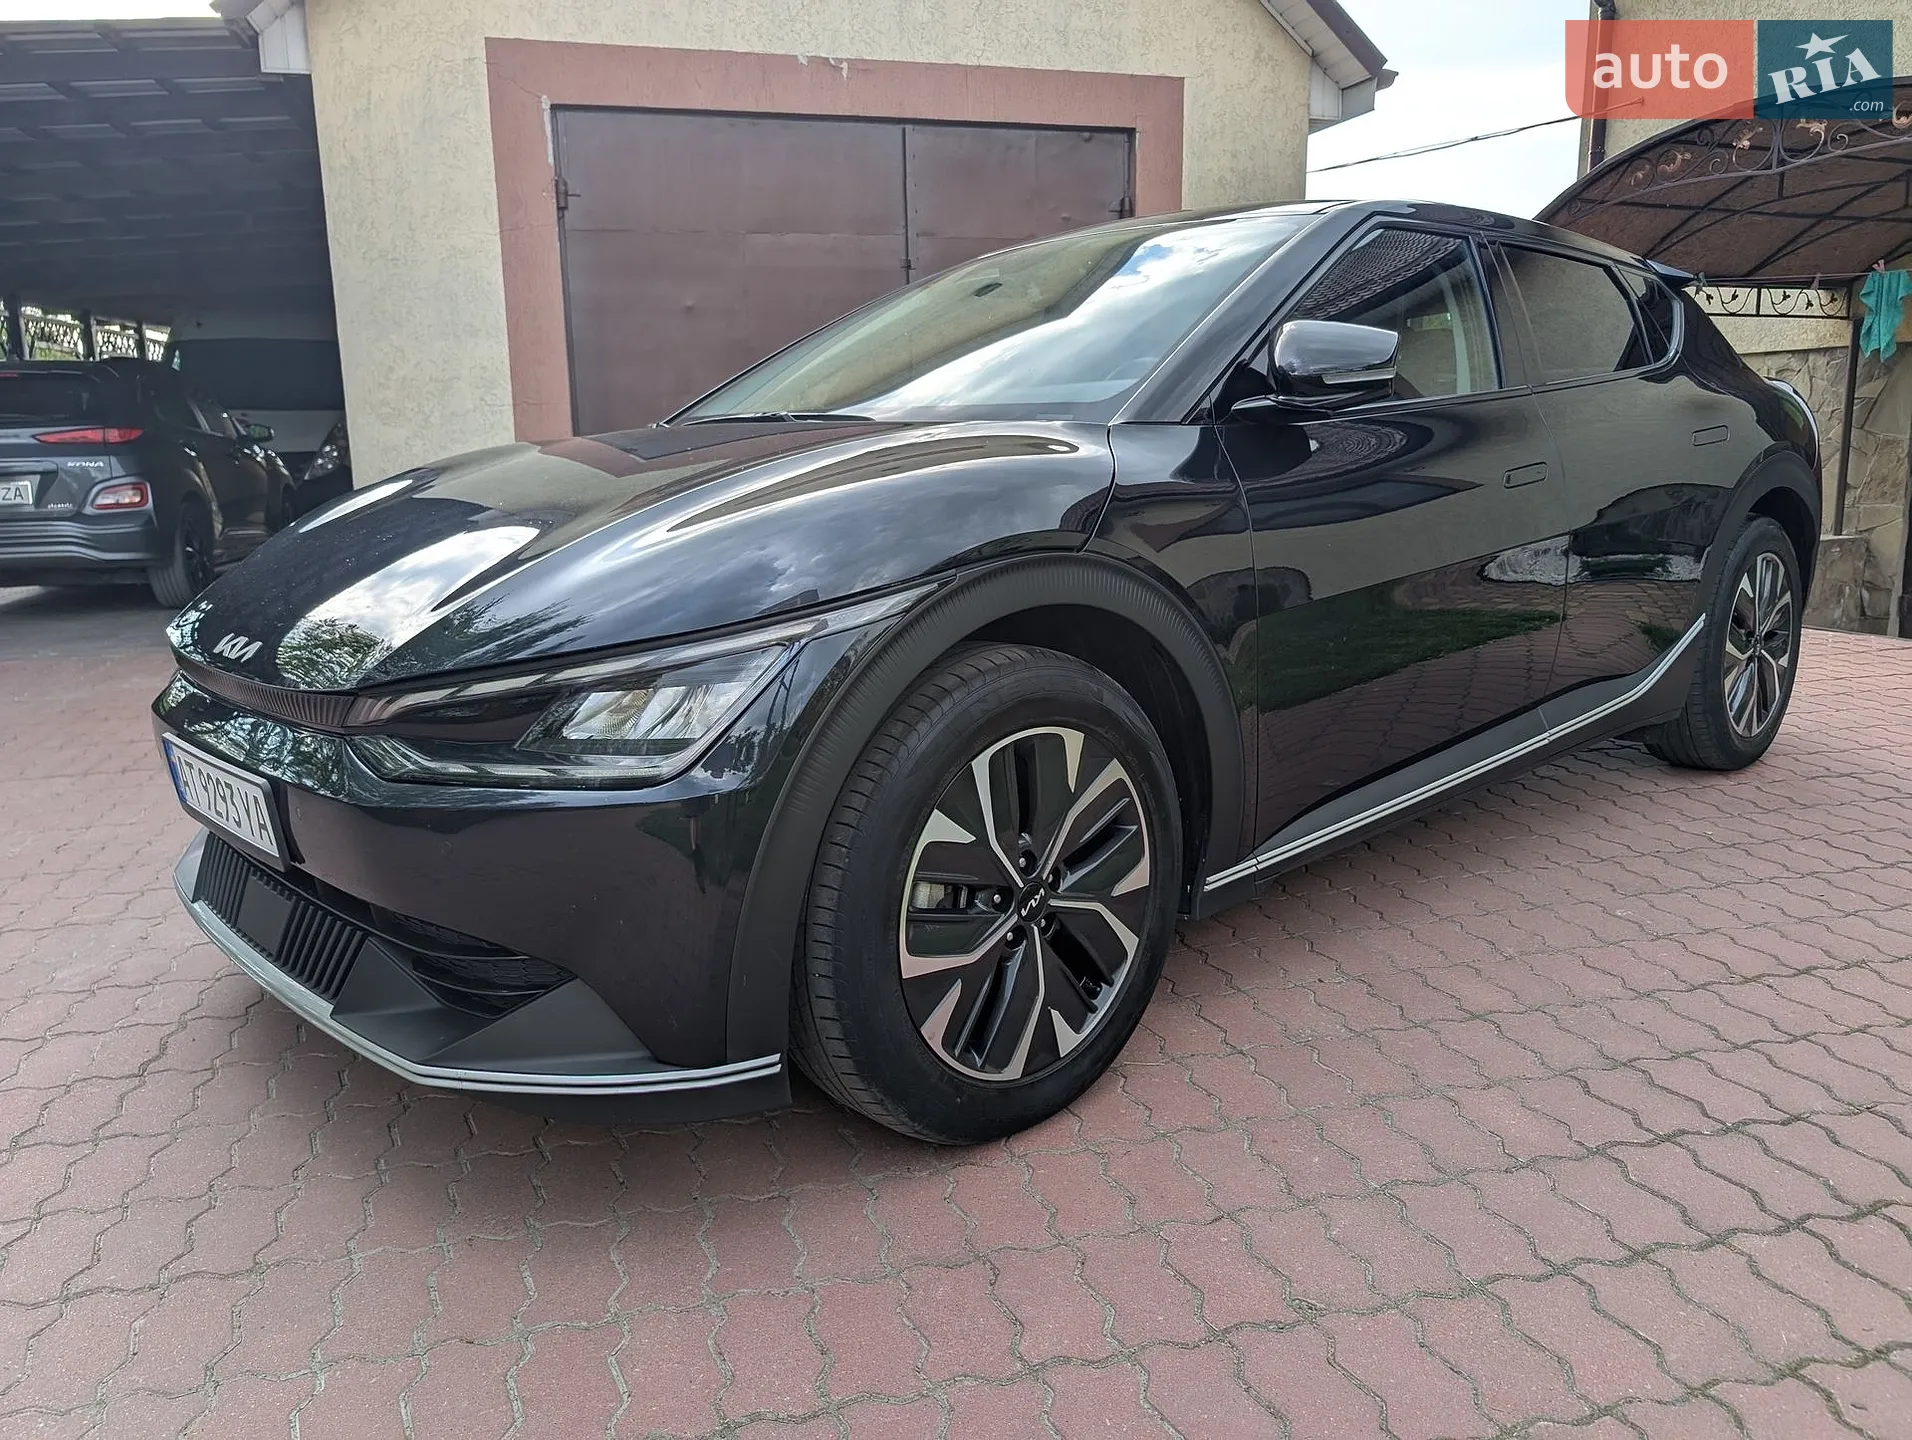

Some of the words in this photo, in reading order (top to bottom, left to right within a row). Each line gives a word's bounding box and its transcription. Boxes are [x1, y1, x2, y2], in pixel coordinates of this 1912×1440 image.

[1, 487, 24, 501] ZA
[177, 755, 201, 808] AT
[199, 767, 241, 829] 9293
